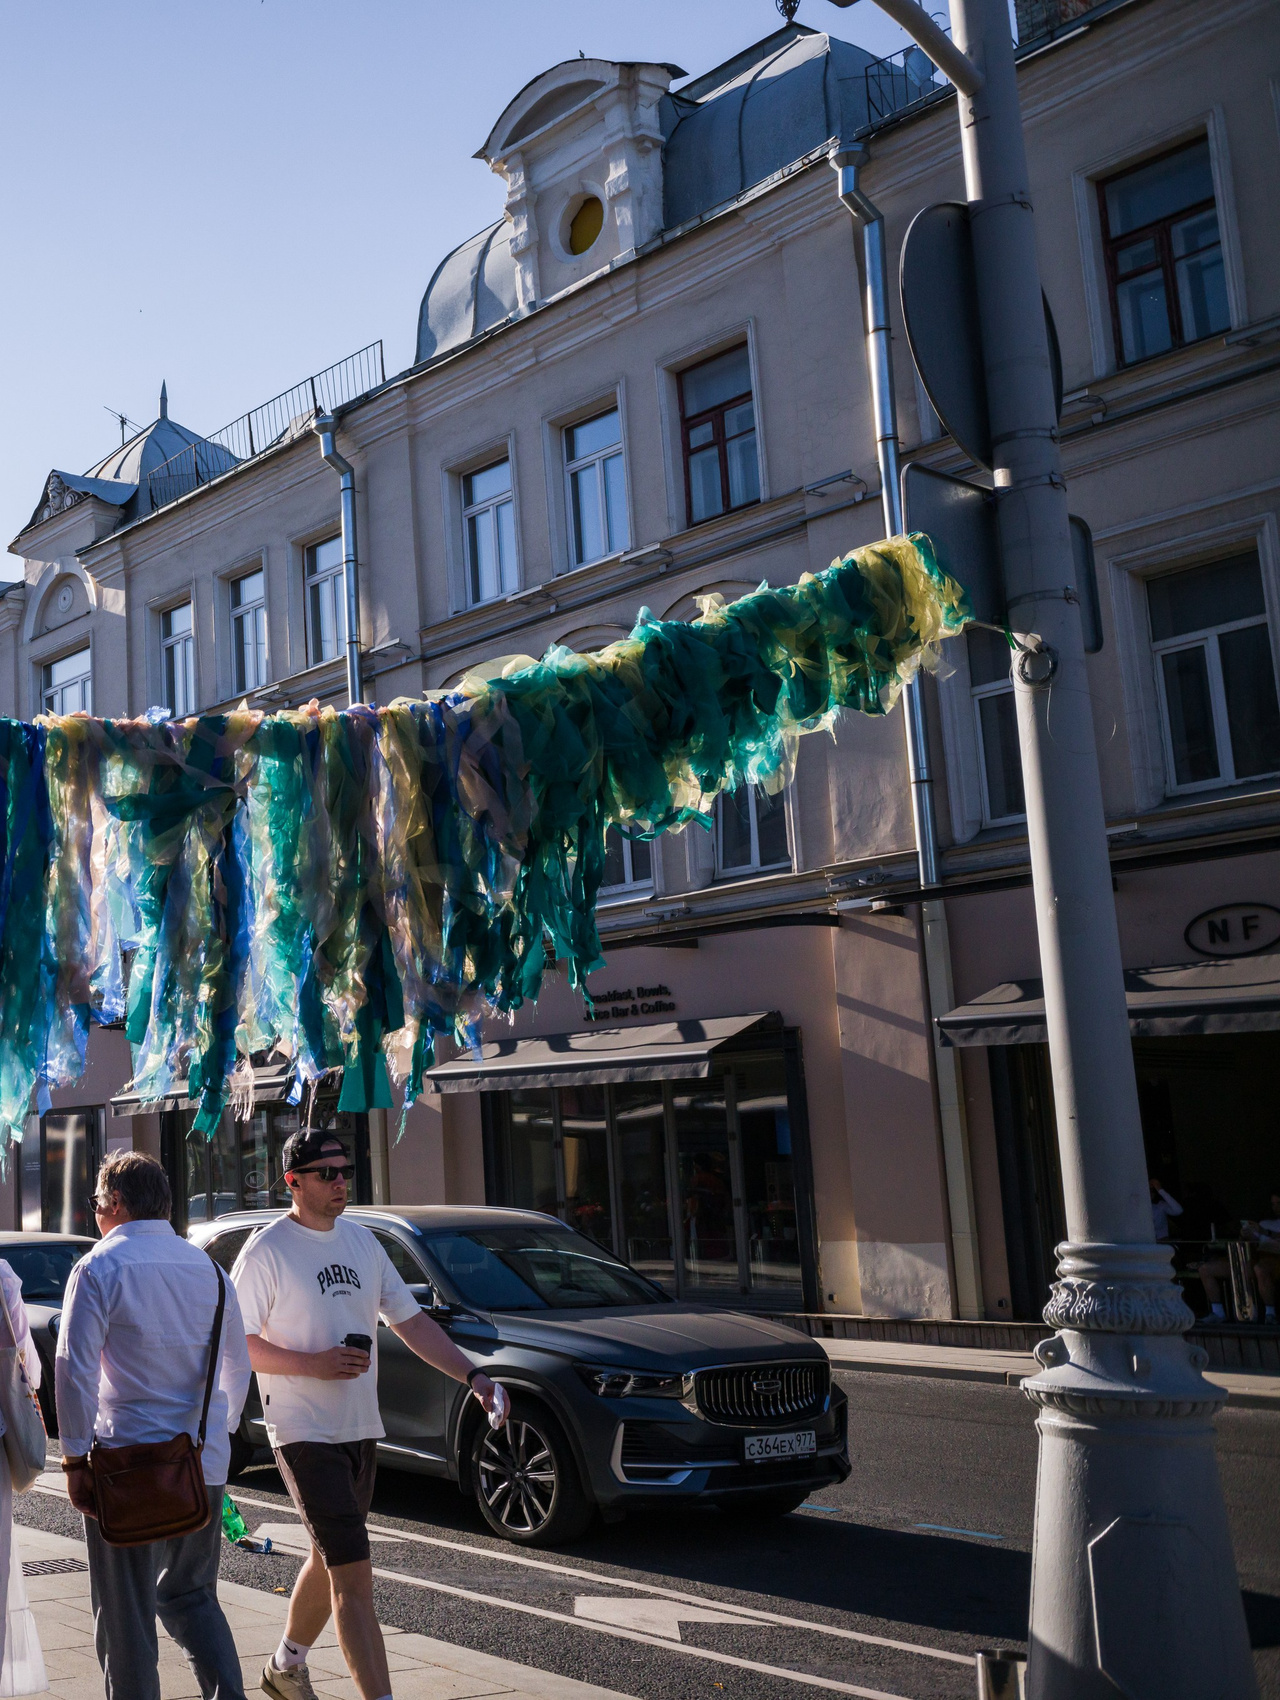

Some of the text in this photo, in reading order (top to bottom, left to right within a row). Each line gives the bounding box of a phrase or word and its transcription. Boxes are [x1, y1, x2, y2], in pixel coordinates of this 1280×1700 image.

[586, 984, 671, 1005] reakfast, Bowls,
[611, 1004, 630, 1018] Bar
[631, 1004, 638, 1016] &
[641, 1001, 676, 1014] Coffee
[317, 1264, 361, 1295] PARIS
[796, 1432, 813, 1447] 977
